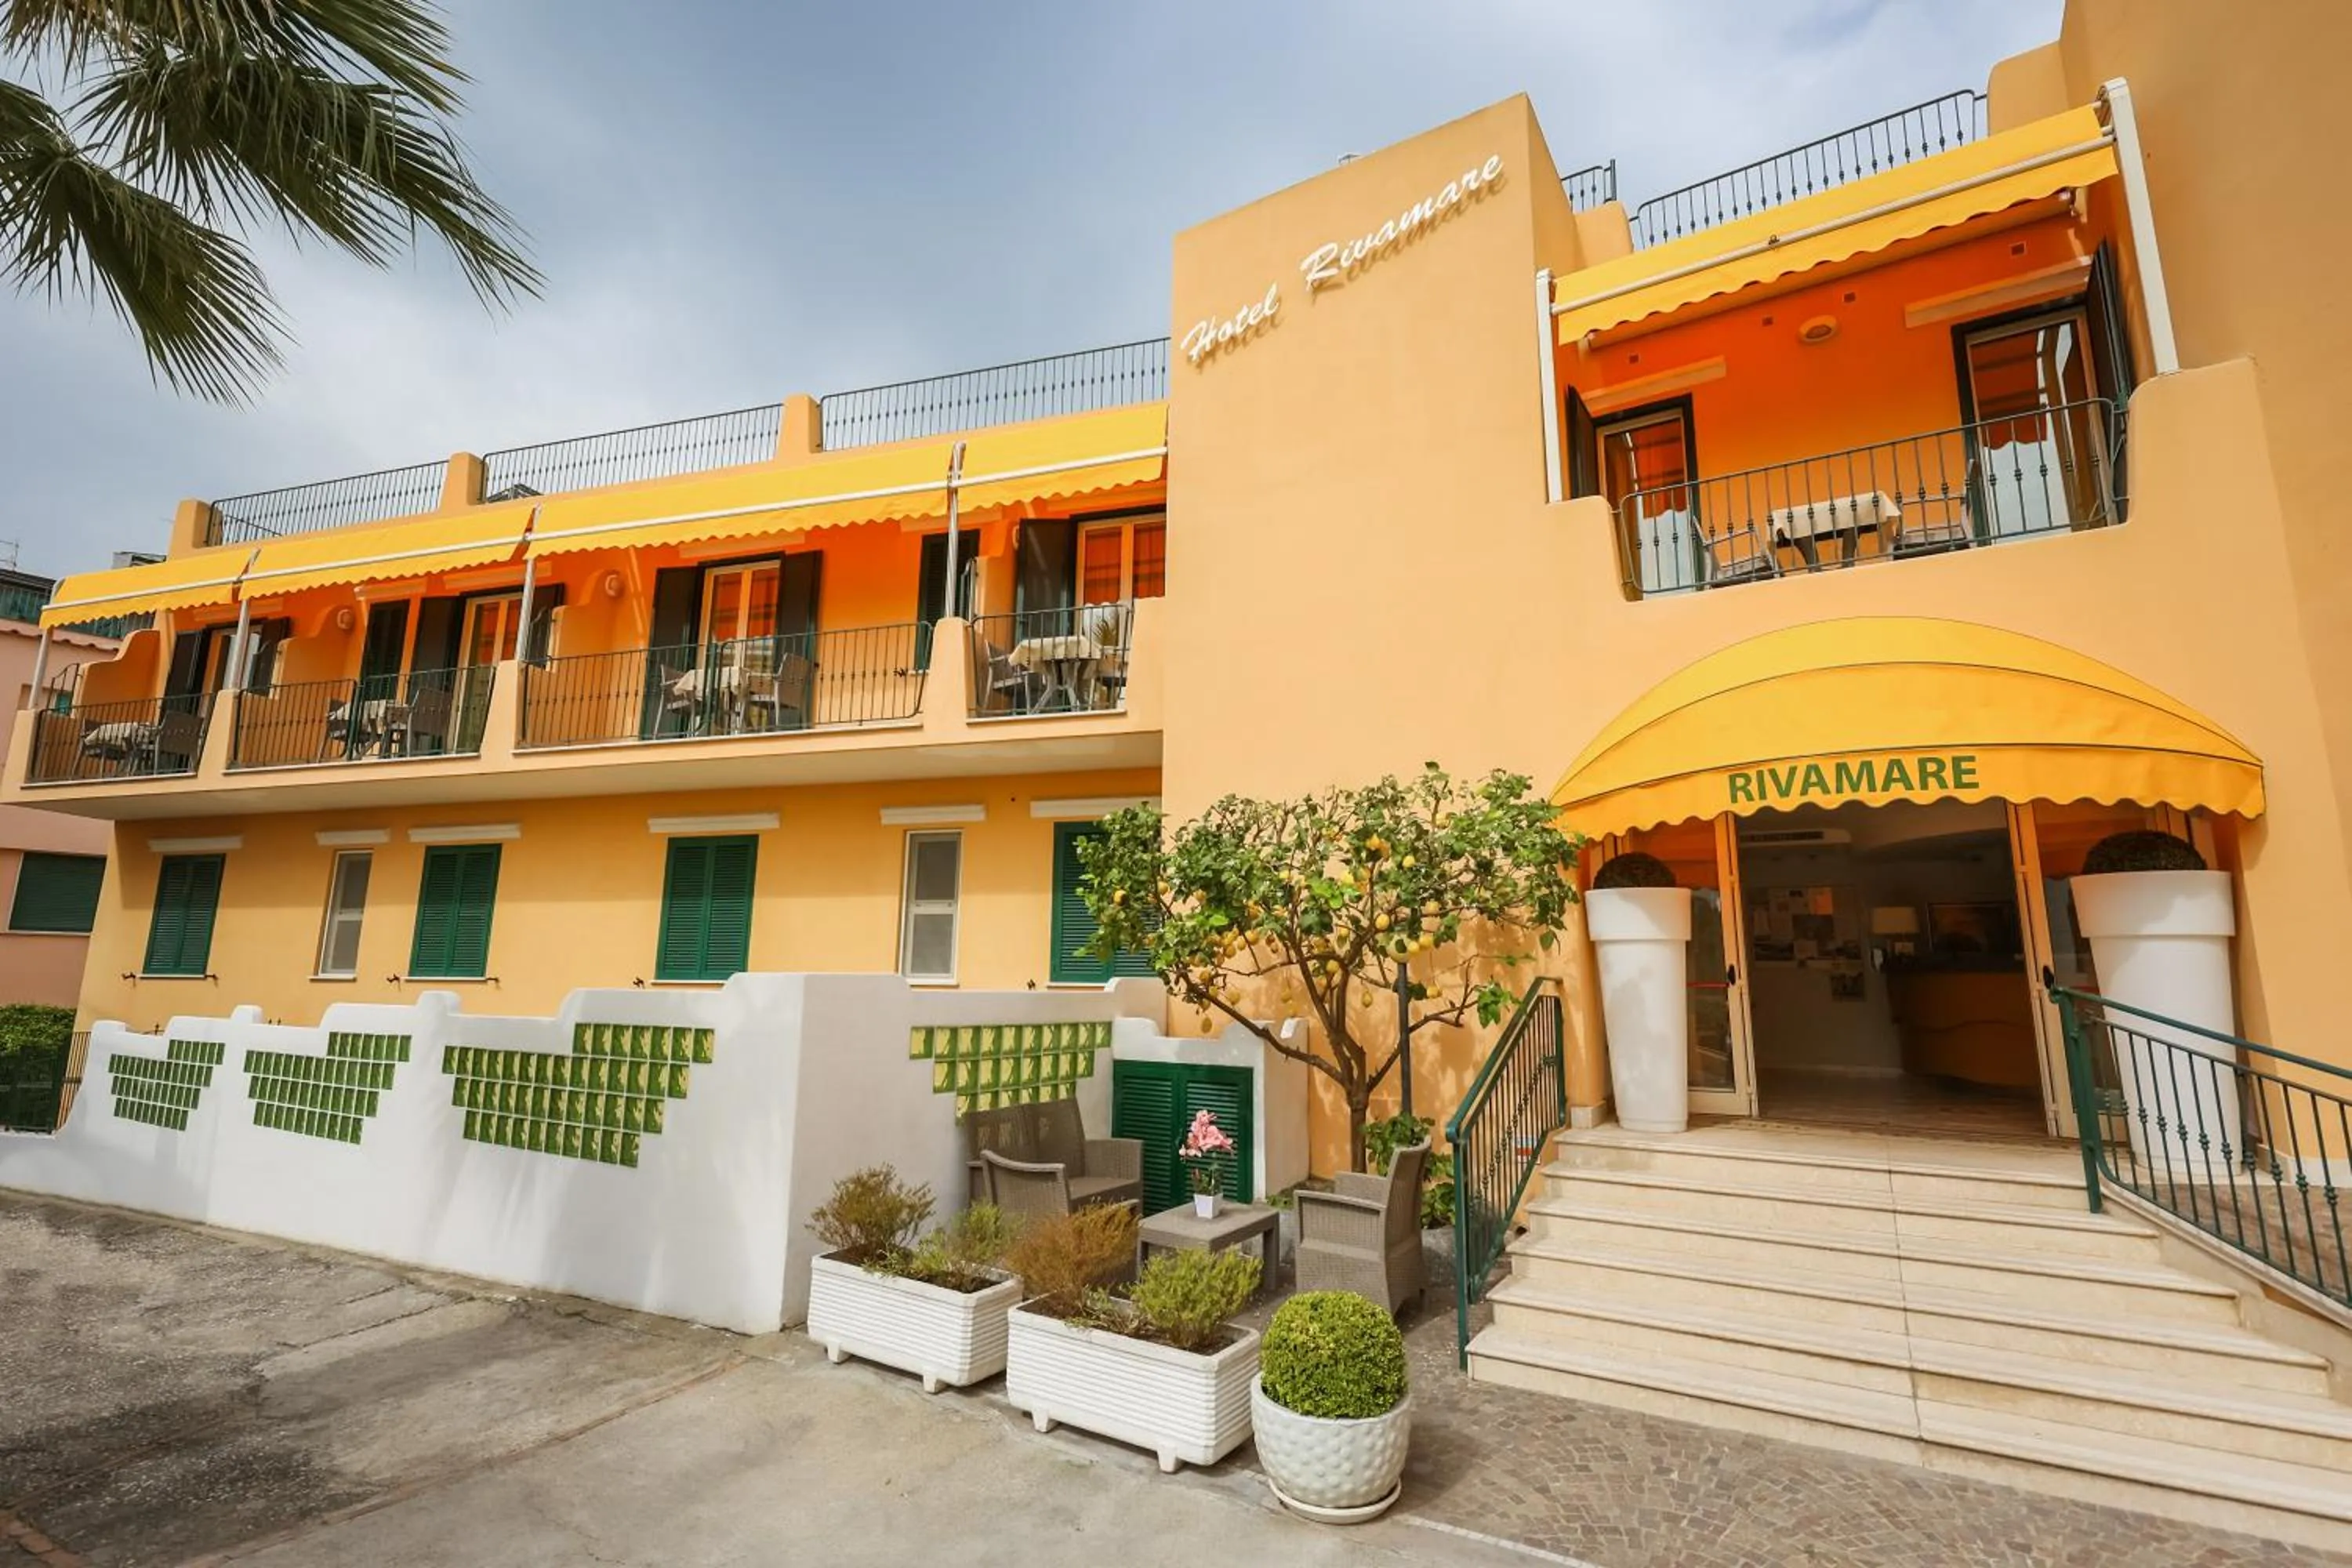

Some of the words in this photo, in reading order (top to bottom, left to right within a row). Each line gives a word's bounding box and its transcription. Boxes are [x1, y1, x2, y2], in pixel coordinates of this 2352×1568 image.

[1181, 283, 1279, 361] Hotel
[1300, 154, 1503, 291] Rivamare
[1728, 755, 1980, 804] RIVAMARE
